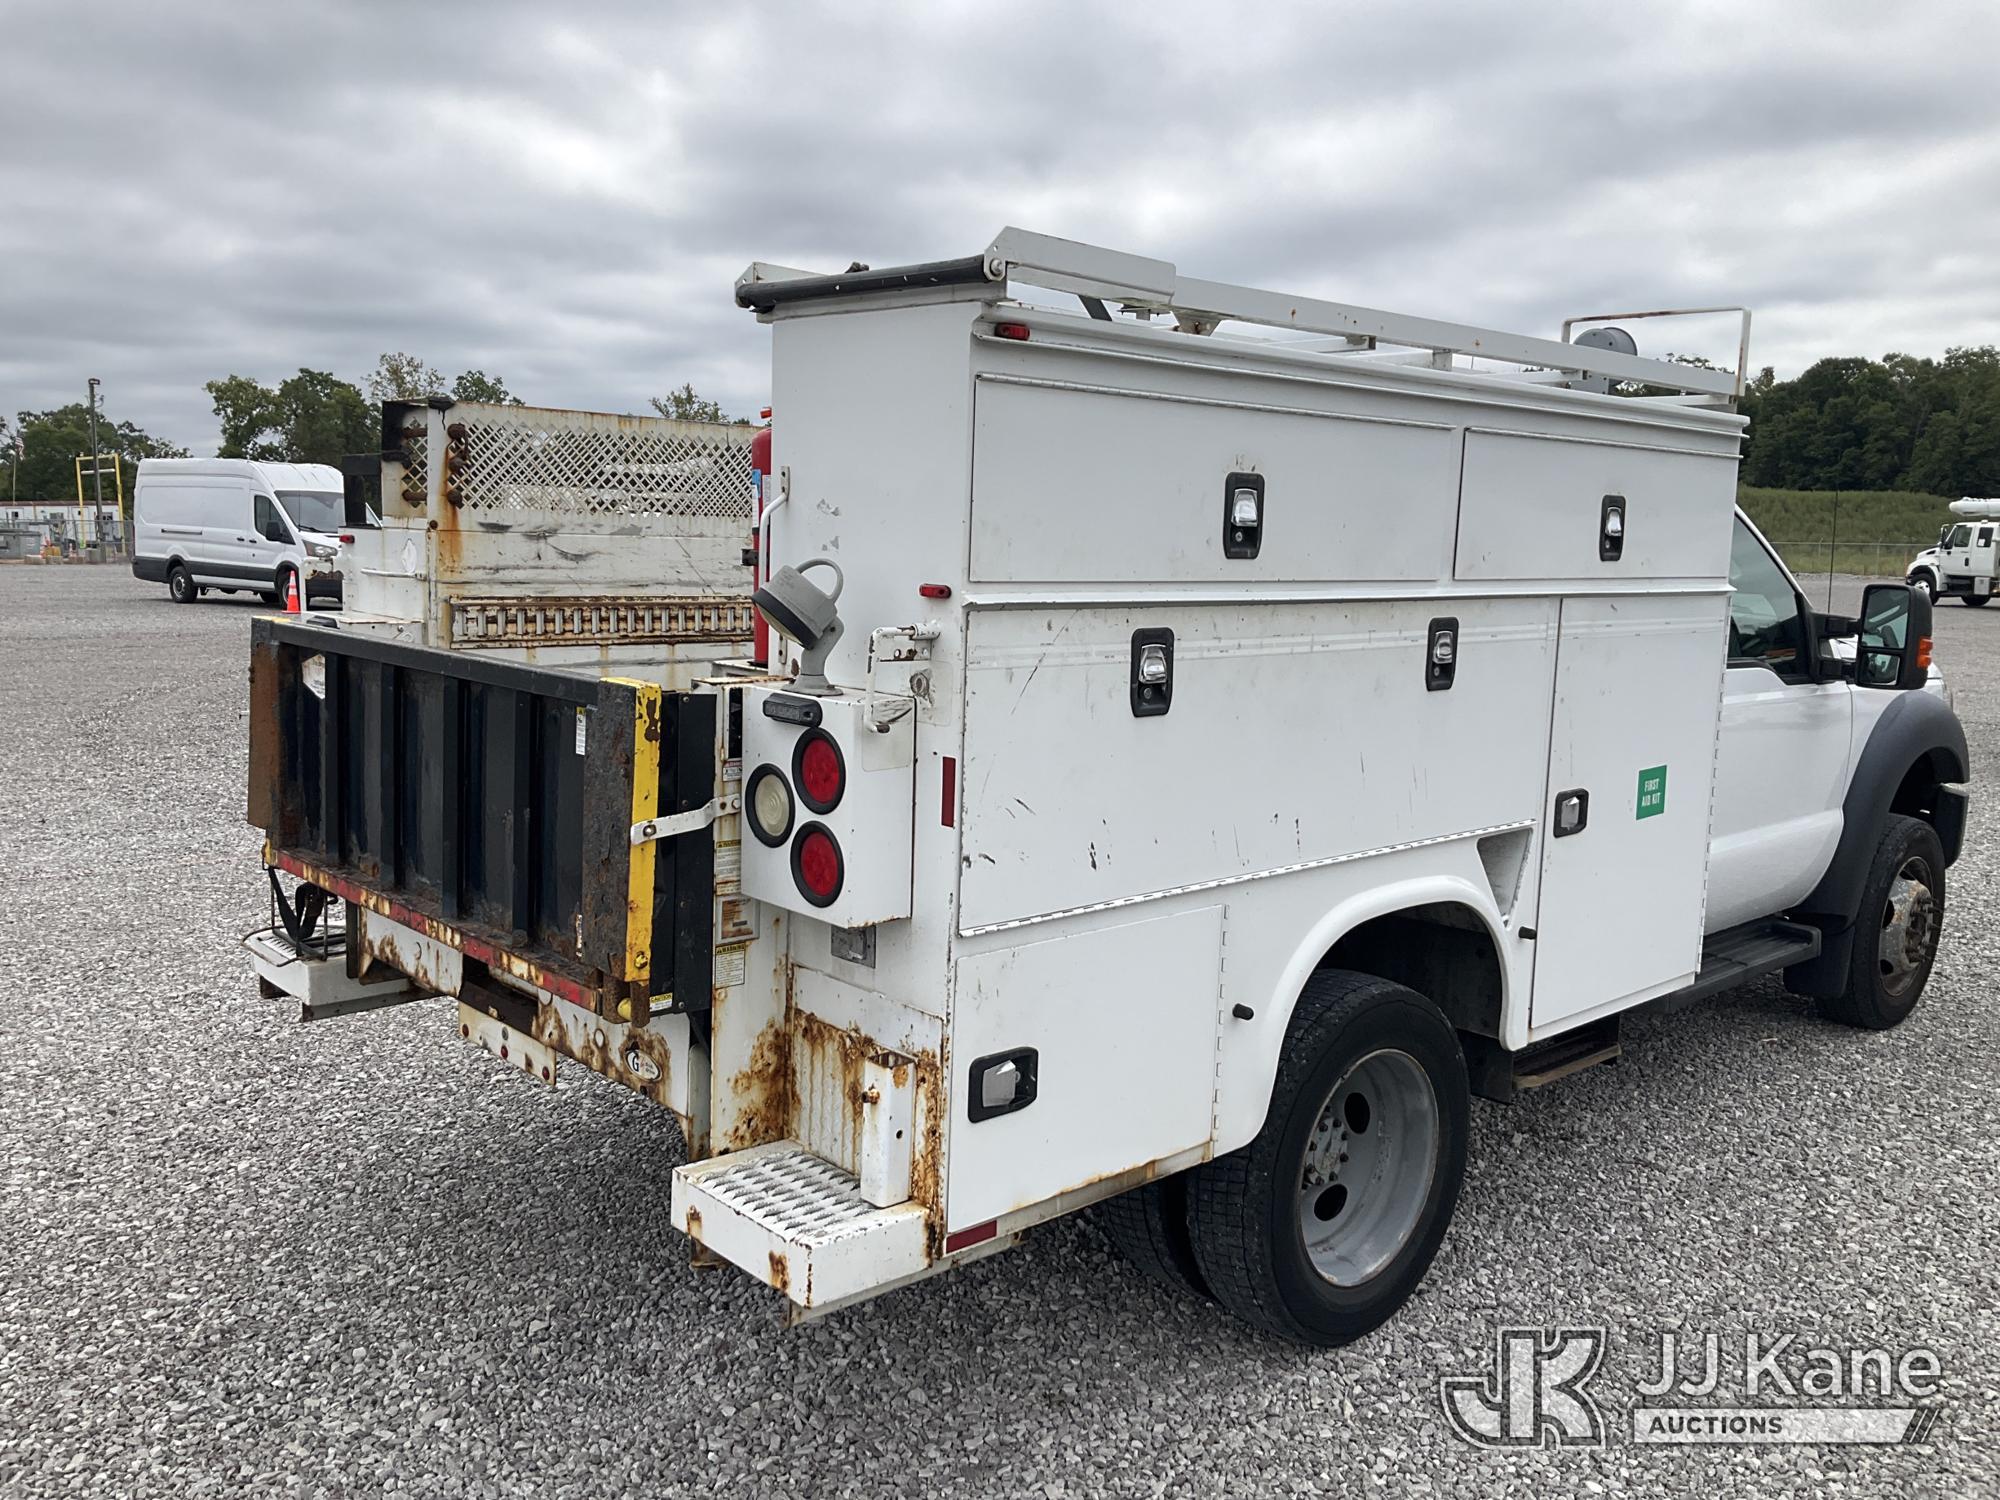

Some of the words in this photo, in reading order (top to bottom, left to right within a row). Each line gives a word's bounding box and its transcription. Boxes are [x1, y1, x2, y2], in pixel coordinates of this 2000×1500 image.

[1644, 778, 1660, 792] FIRST
[1641, 794, 1651, 807] AID
[1652, 792, 1661, 805] KIT
